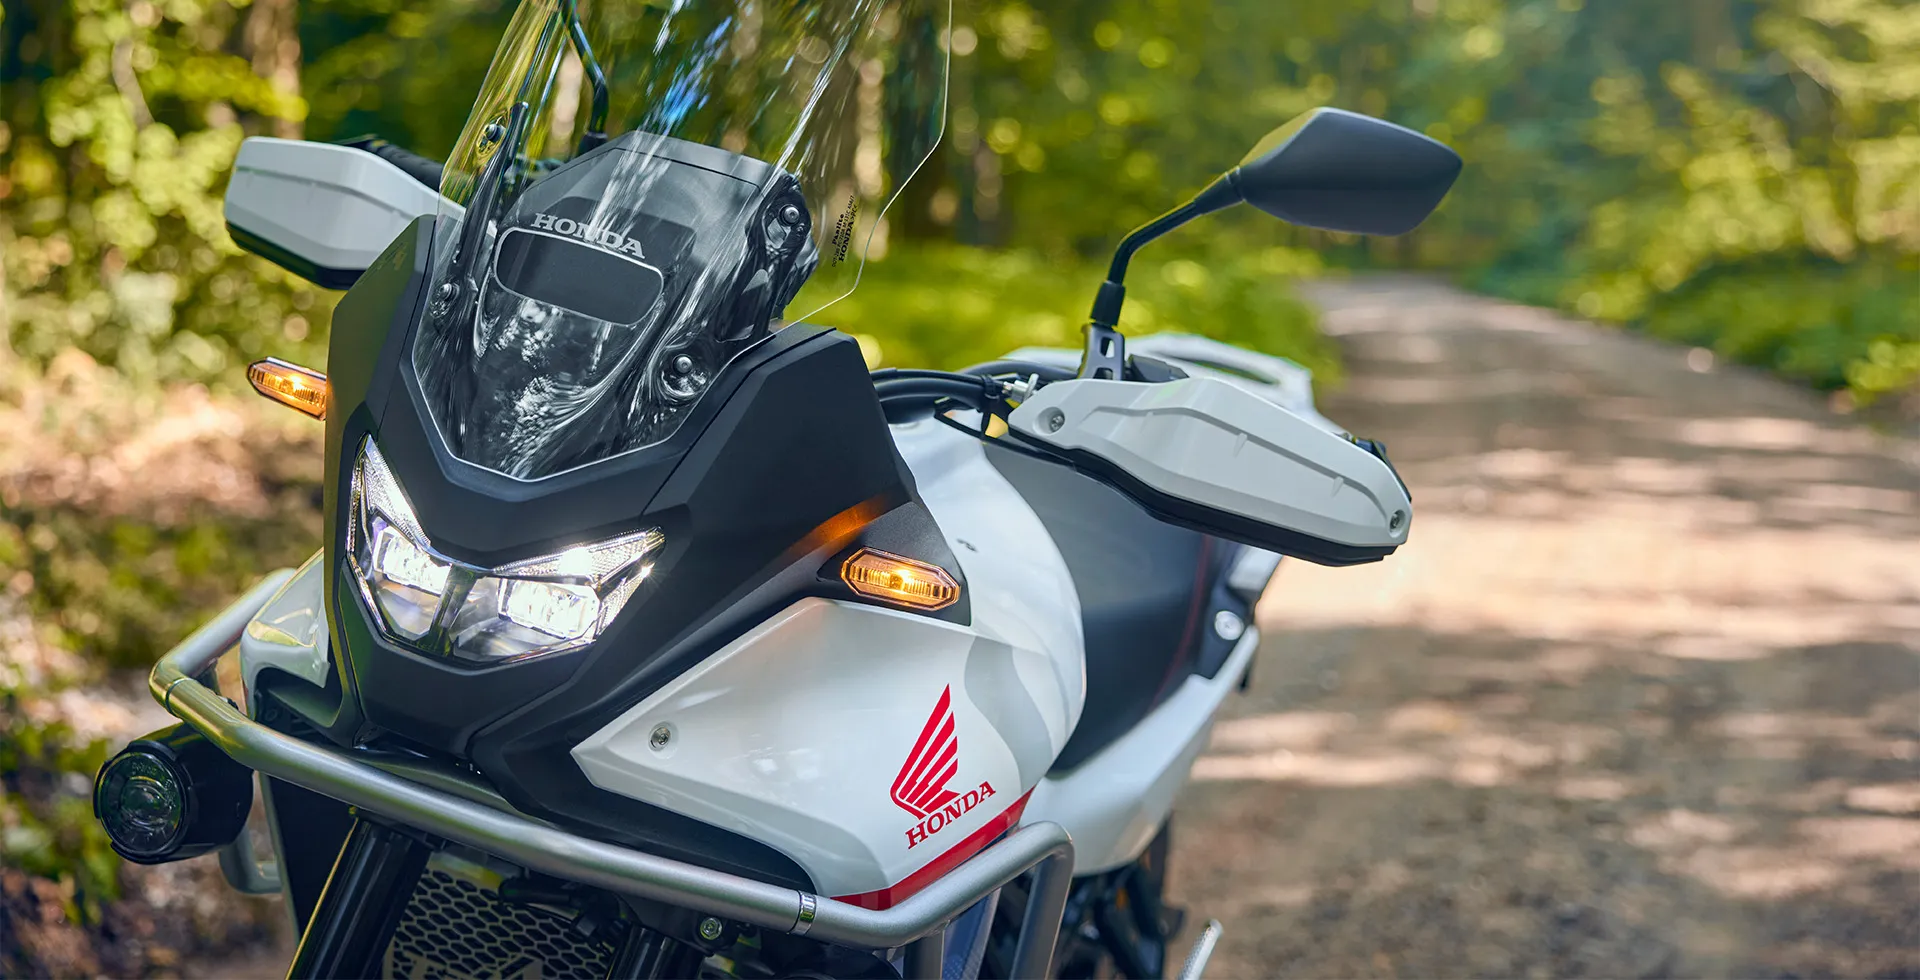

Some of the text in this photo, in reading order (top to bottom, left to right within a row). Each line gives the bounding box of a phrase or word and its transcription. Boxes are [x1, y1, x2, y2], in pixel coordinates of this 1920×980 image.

[530, 212, 646, 260] HONDA
[838, 221, 854, 262] HONDA
[905, 780, 997, 850] HONDA
